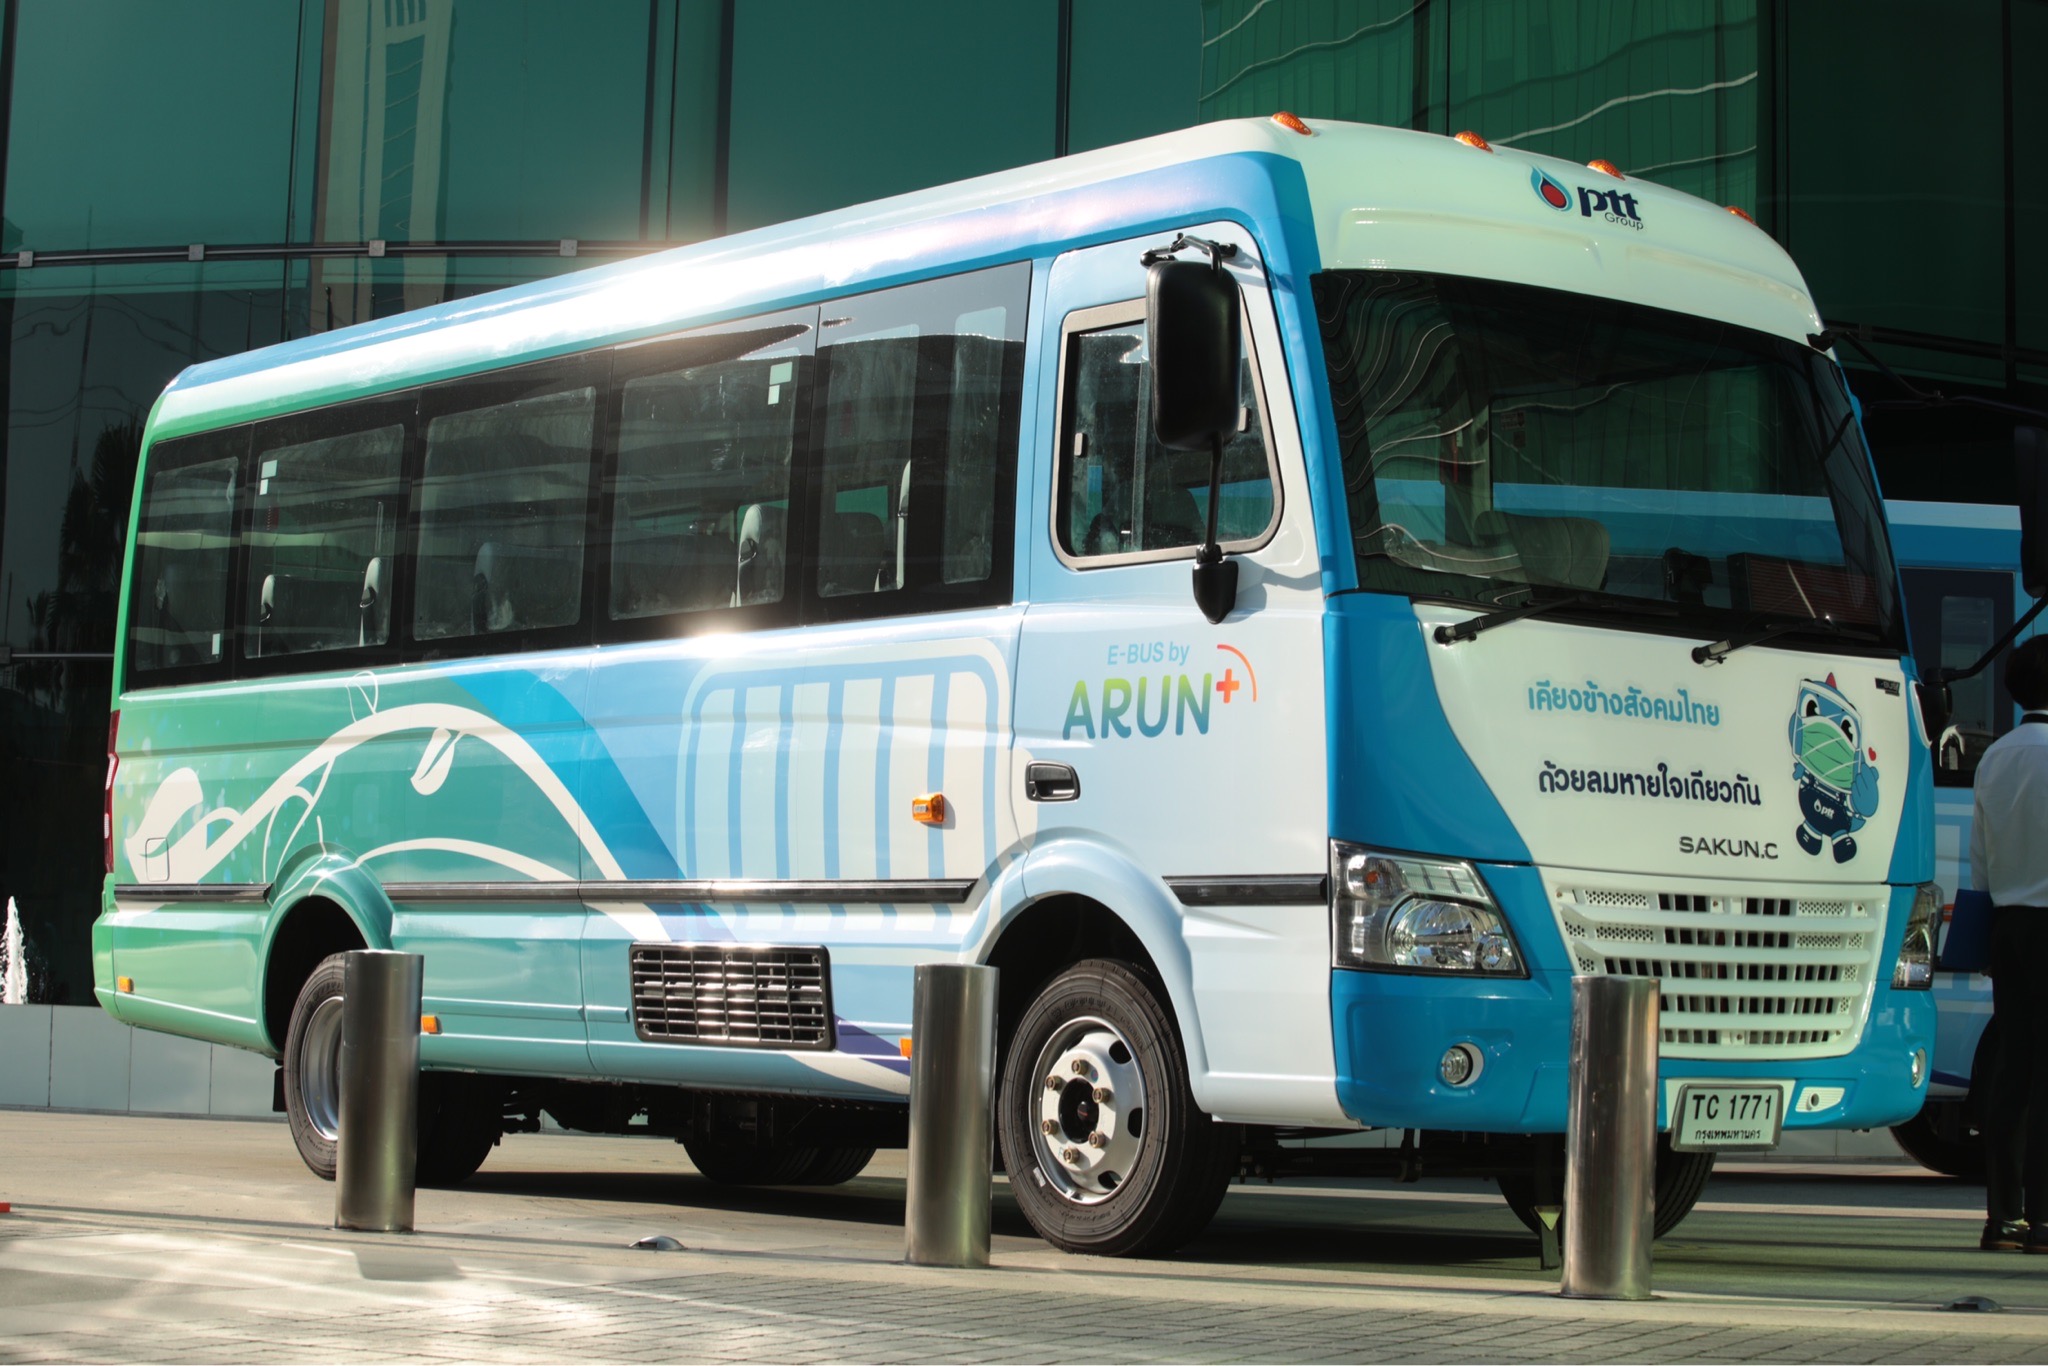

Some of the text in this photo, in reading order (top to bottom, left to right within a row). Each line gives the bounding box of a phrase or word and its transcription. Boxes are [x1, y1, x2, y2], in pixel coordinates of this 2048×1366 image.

[1577, 186, 1641, 221] ptt
[1604, 212, 1644, 231] Group
[1107, 641, 1190, 666] E-BUS by
[1528, 680, 1720, 726] เคียงข้างสังคมไทย
[1538, 761, 1762, 806] ด้วยลมหายใจเดียวกัน
[1679, 836, 1779, 860] SAKUN.C
[1692, 1094, 1772, 1120] TC 1771
[1695, 1129, 1761, 1144] กรุงเทพมหานคร
